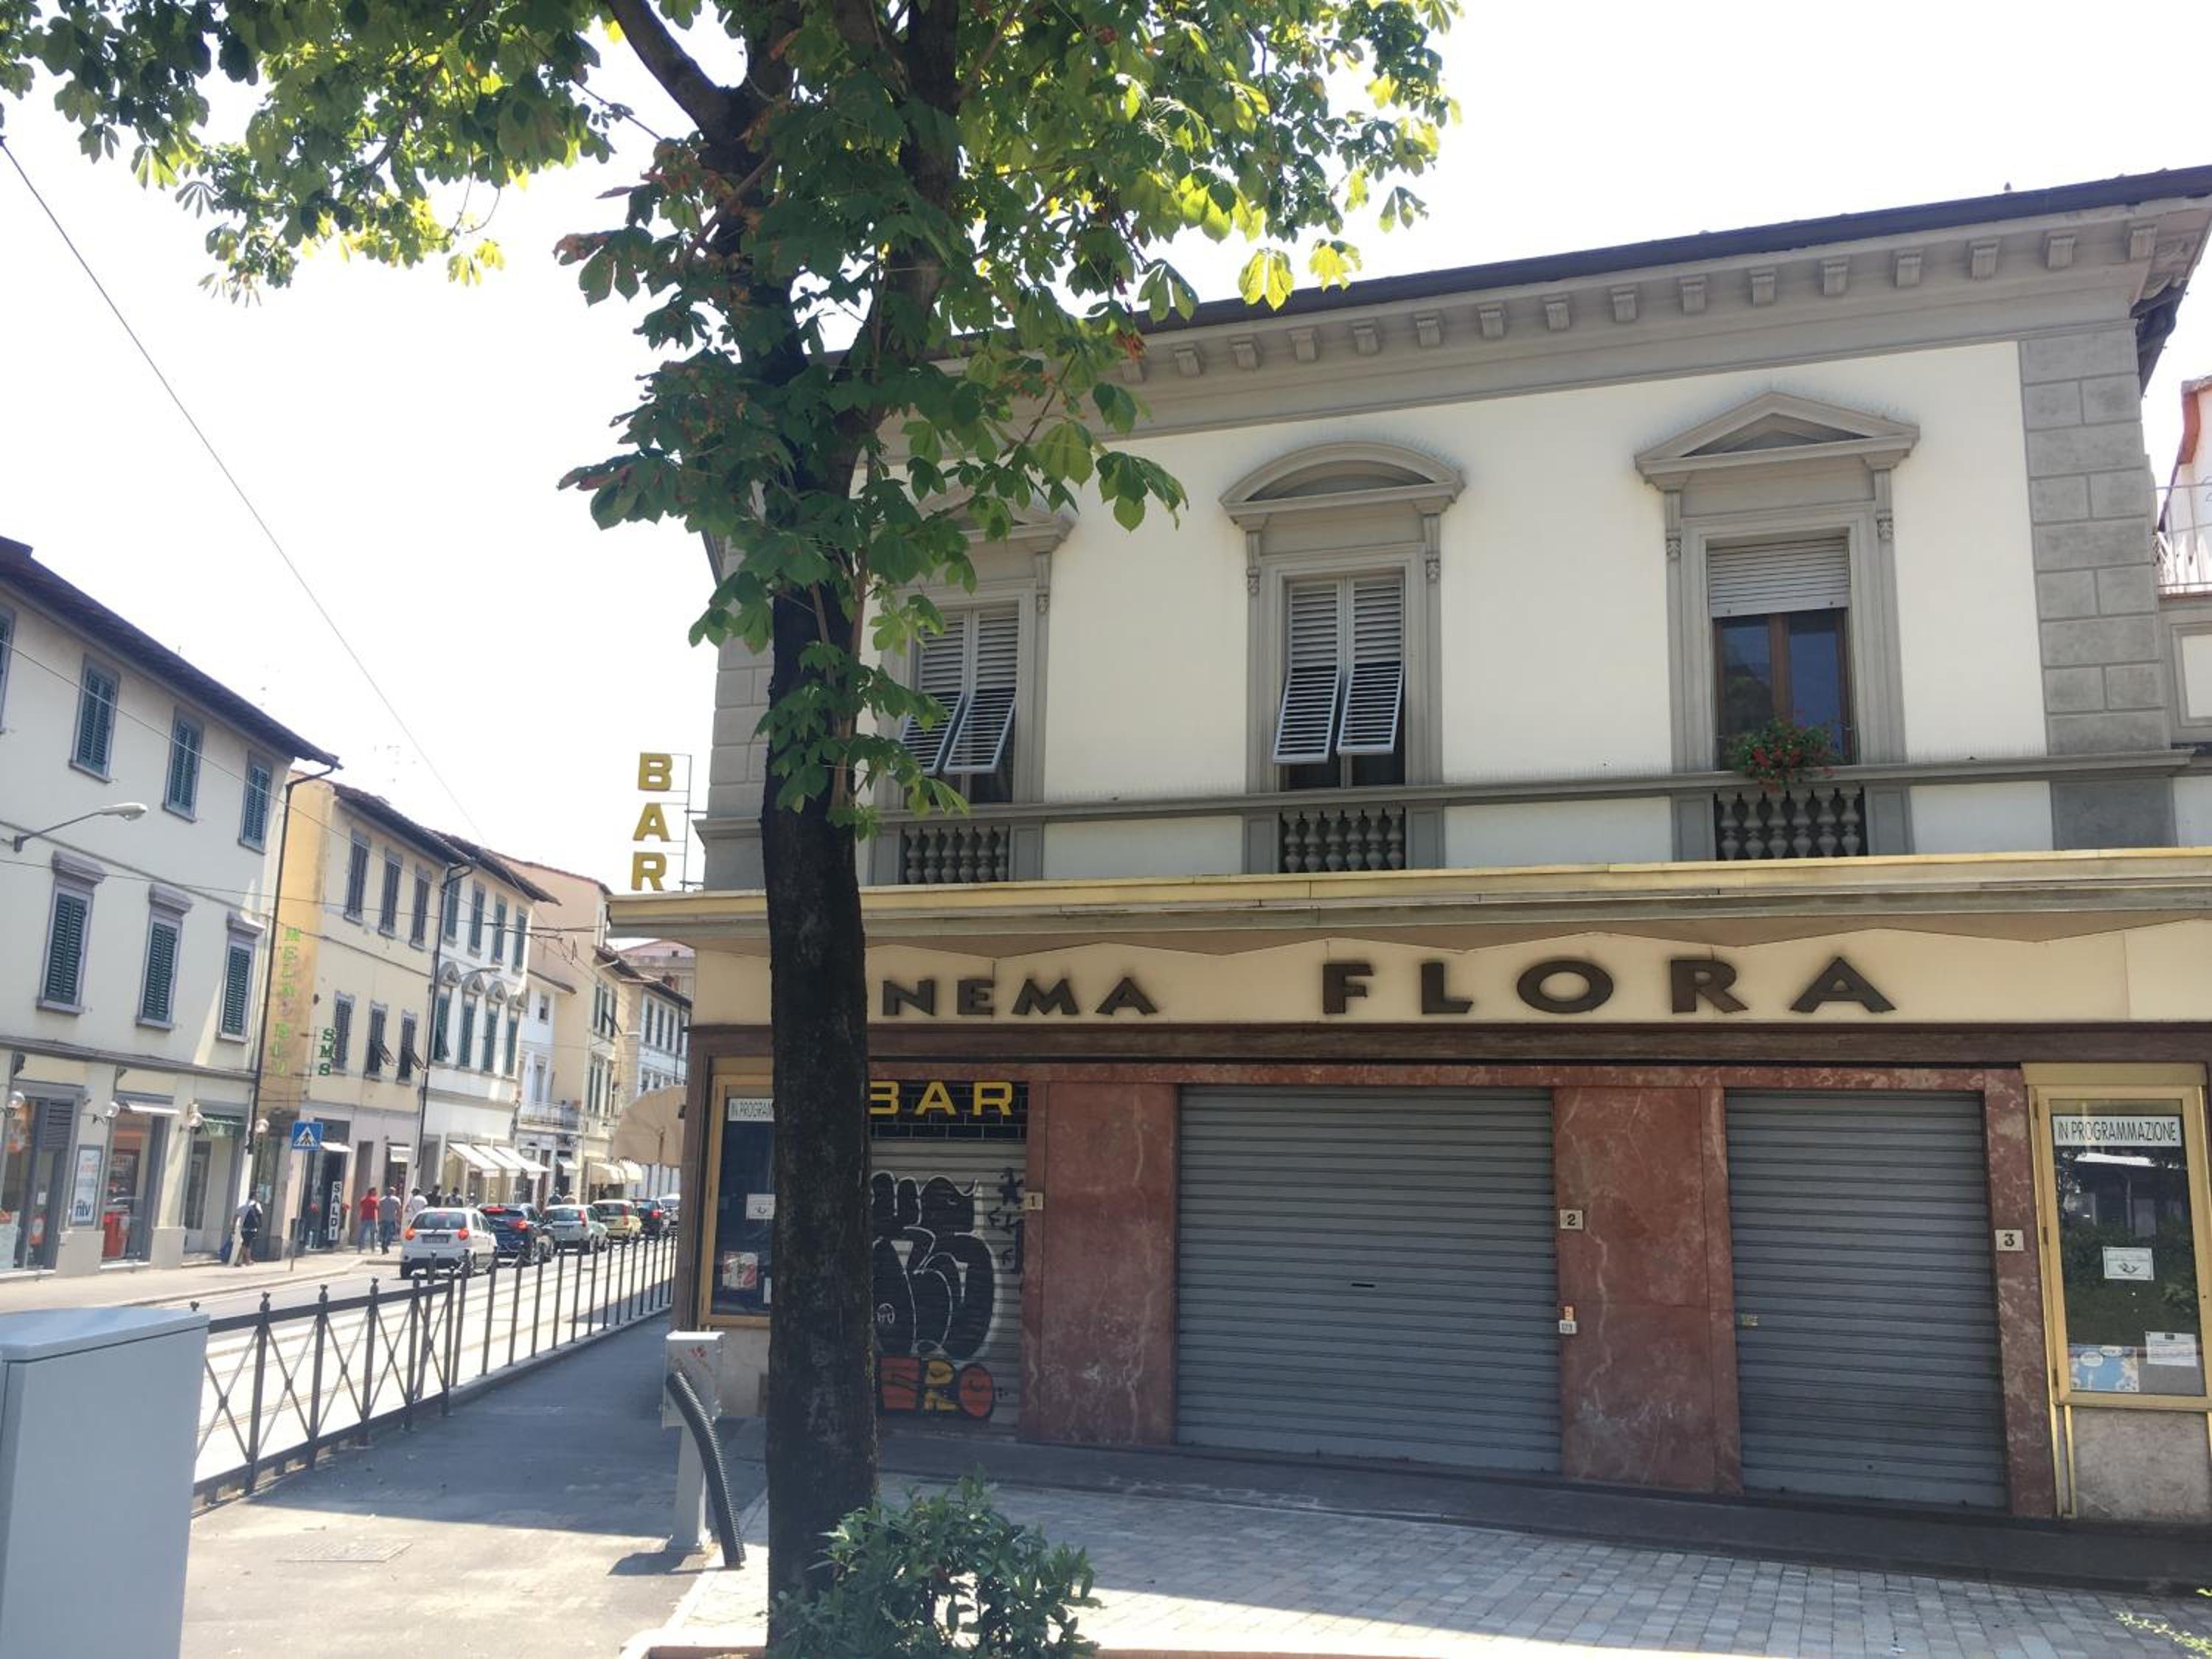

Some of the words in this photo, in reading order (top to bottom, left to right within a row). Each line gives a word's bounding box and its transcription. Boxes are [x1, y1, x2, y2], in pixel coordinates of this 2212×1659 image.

[631, 752, 672, 891] BAR
[882, 976, 1158, 1016] NEMA
[1322, 956, 1897, 1015] FLORA
[319, 1028, 335, 1076] SMS
[869, 1080, 1013, 1116] BAR
[2058, 1121, 2068, 1140] IN
[2072, 1121, 2177, 1141] PROGRAMMAZIONE
[331, 1183, 340, 1238] SALDI
[1567, 1214, 1576, 1226] 2
[2004, 1233, 2015, 1247] 3
